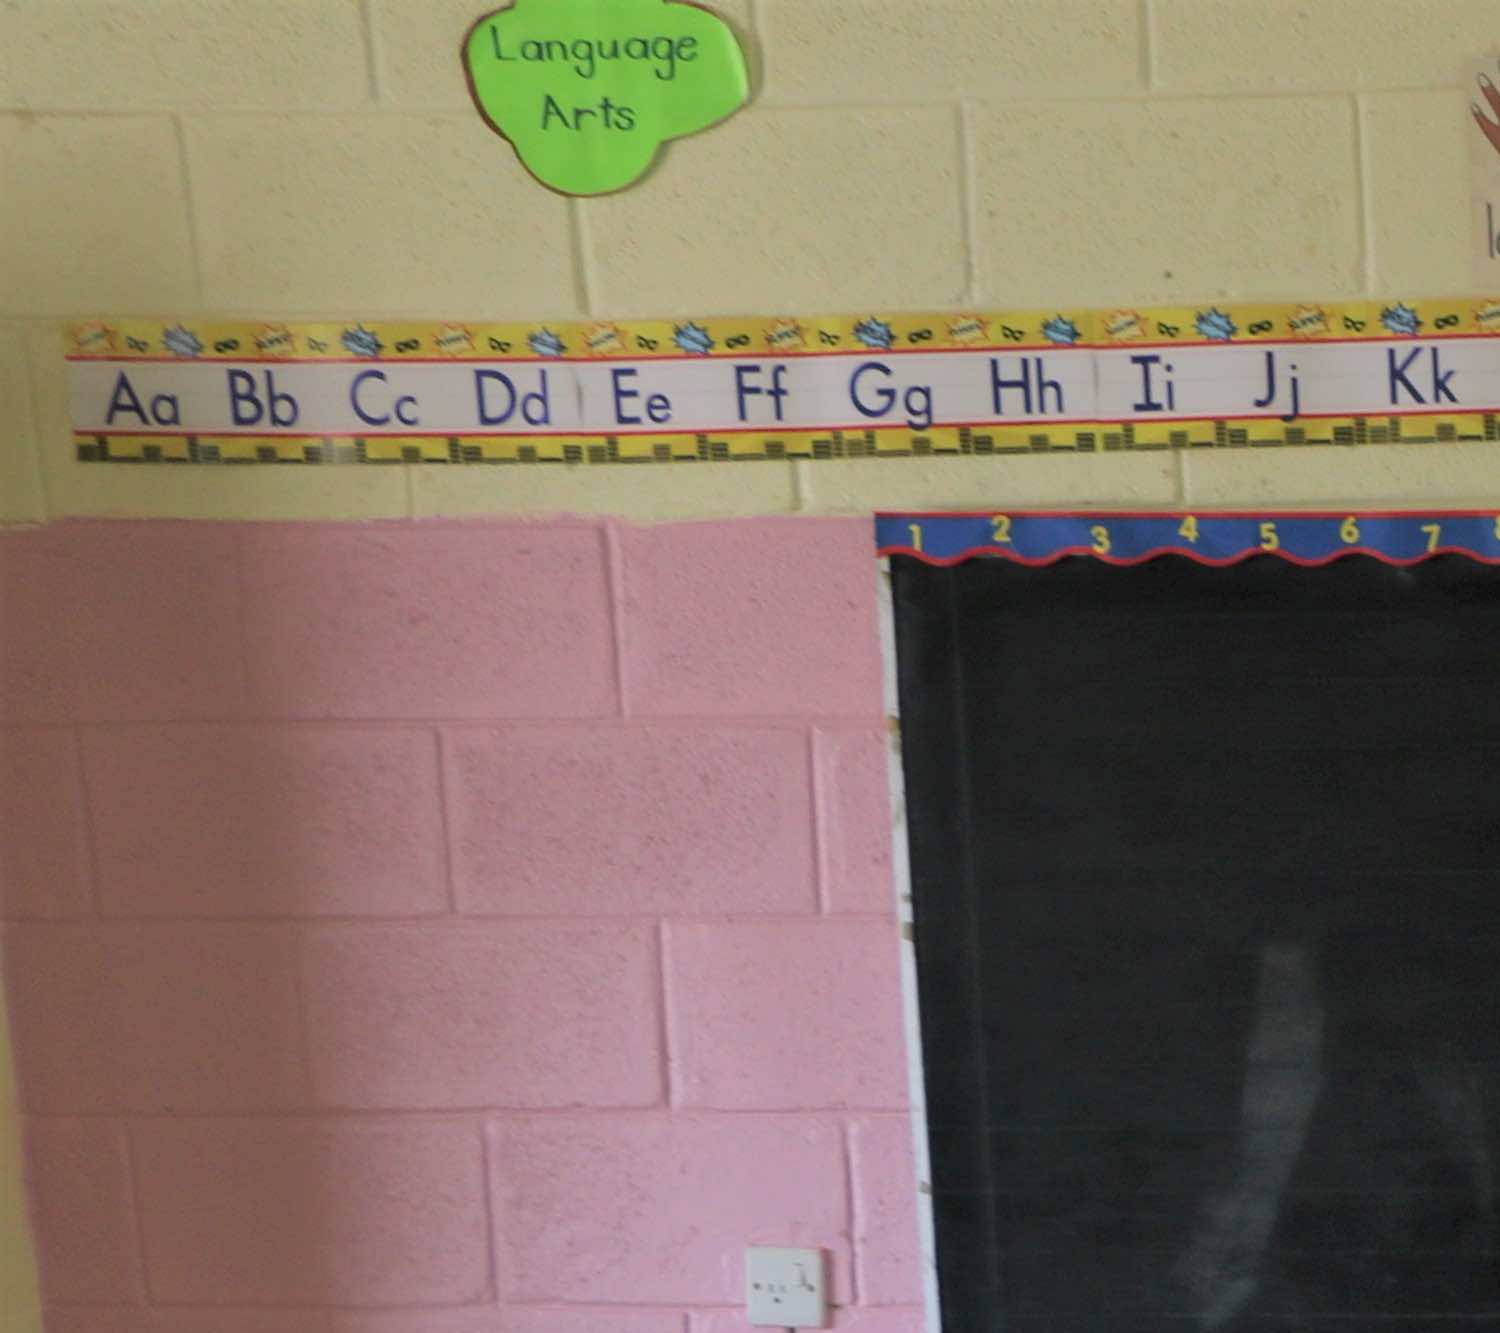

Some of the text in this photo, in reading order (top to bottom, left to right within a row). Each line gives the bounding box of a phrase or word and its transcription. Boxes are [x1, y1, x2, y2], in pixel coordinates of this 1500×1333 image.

[493, 23, 699, 80] Language
[541, 98, 637, 132] Arts
[107, 371, 180, 424] Aa
[227, 369, 298, 427] Bb
[350, 370, 418, 425] Cc
[474, 370, 549, 425] Dd
[611, 369, 670, 424] Ee
[735, 365, 788, 420] Ff
[850, 362, 932, 431] Gg
[990, 358, 1063, 414] Hh
[1131, 355, 1174, 412] Ii
[1254, 351, 1299, 421] Jj
[1388, 347, 1457, 404] Kk
[910, 525, 921, 552] 1
[991, 516, 1012, 542] 2
[1091, 526, 1110, 553] 3
[1179, 517, 1198, 540] 4
[1261, 523, 1278, 553] 5
[1340, 517, 1359, 543] 6
[1423, 524, 1440, 550] 7
